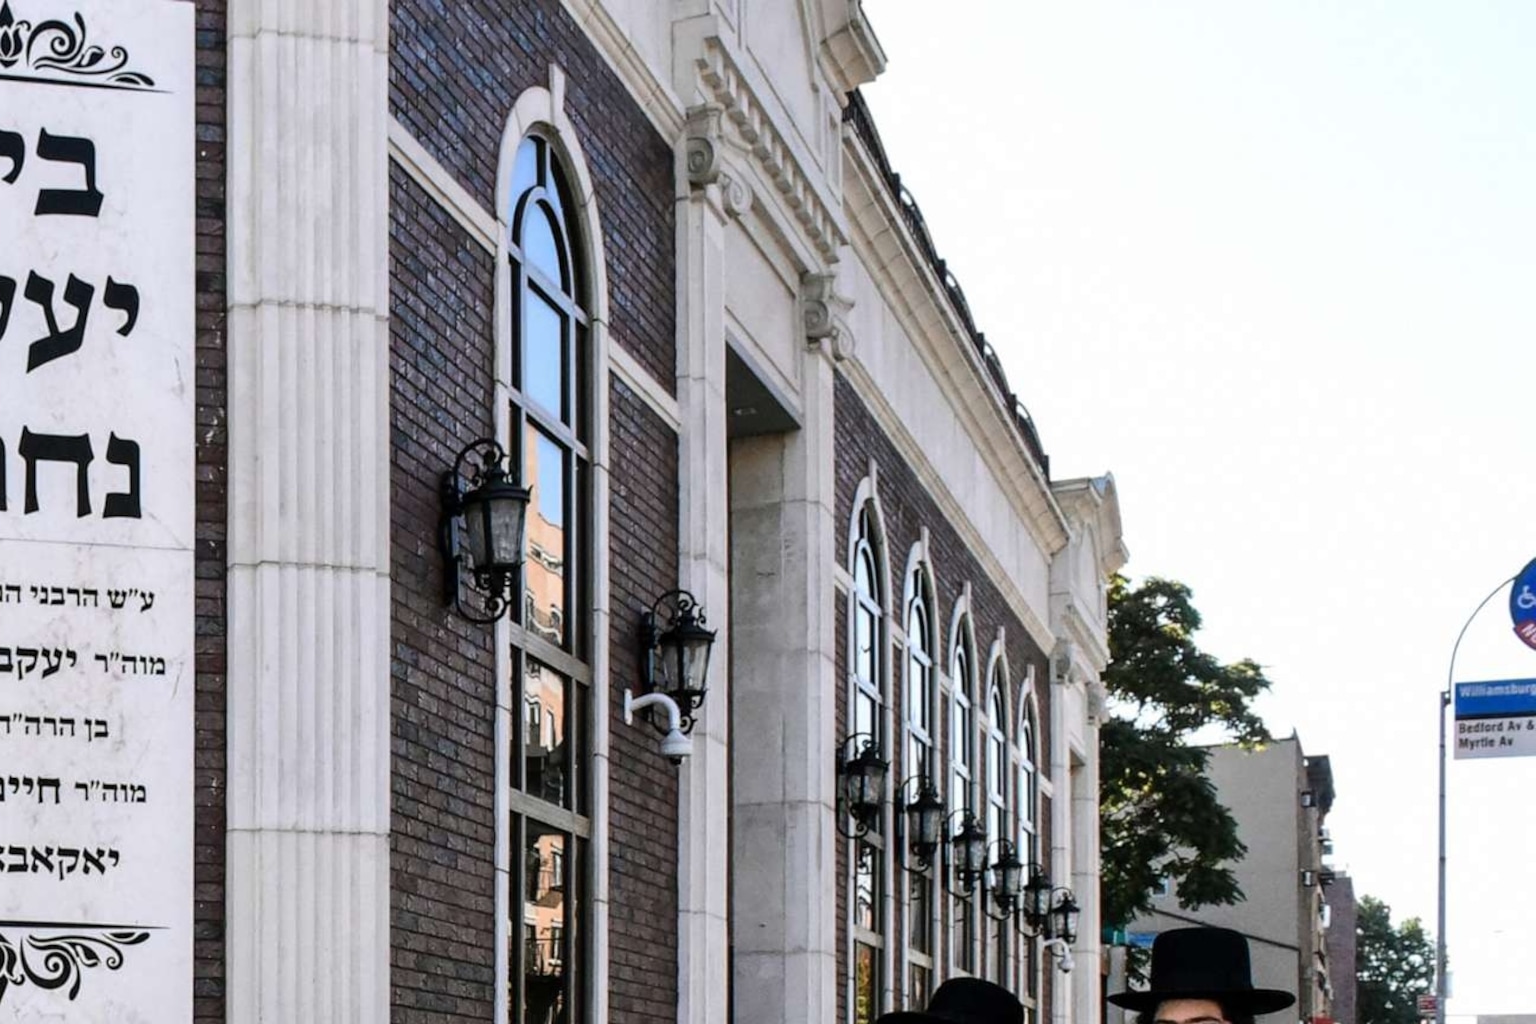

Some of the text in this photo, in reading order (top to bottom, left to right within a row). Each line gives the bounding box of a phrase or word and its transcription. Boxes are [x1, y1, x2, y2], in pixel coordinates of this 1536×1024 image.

[30, 584, 99, 607] הרבני
[106, 587, 155, 612] ע"ש
[93, 650, 166, 676] מוה"ר
[84, 717, 110, 742] בן
[1458, 719, 1535, 734] Bedford Av &
[1458, 736, 1515, 751] Myrtle Av
[74, 780, 148, 804] מוה"ר
